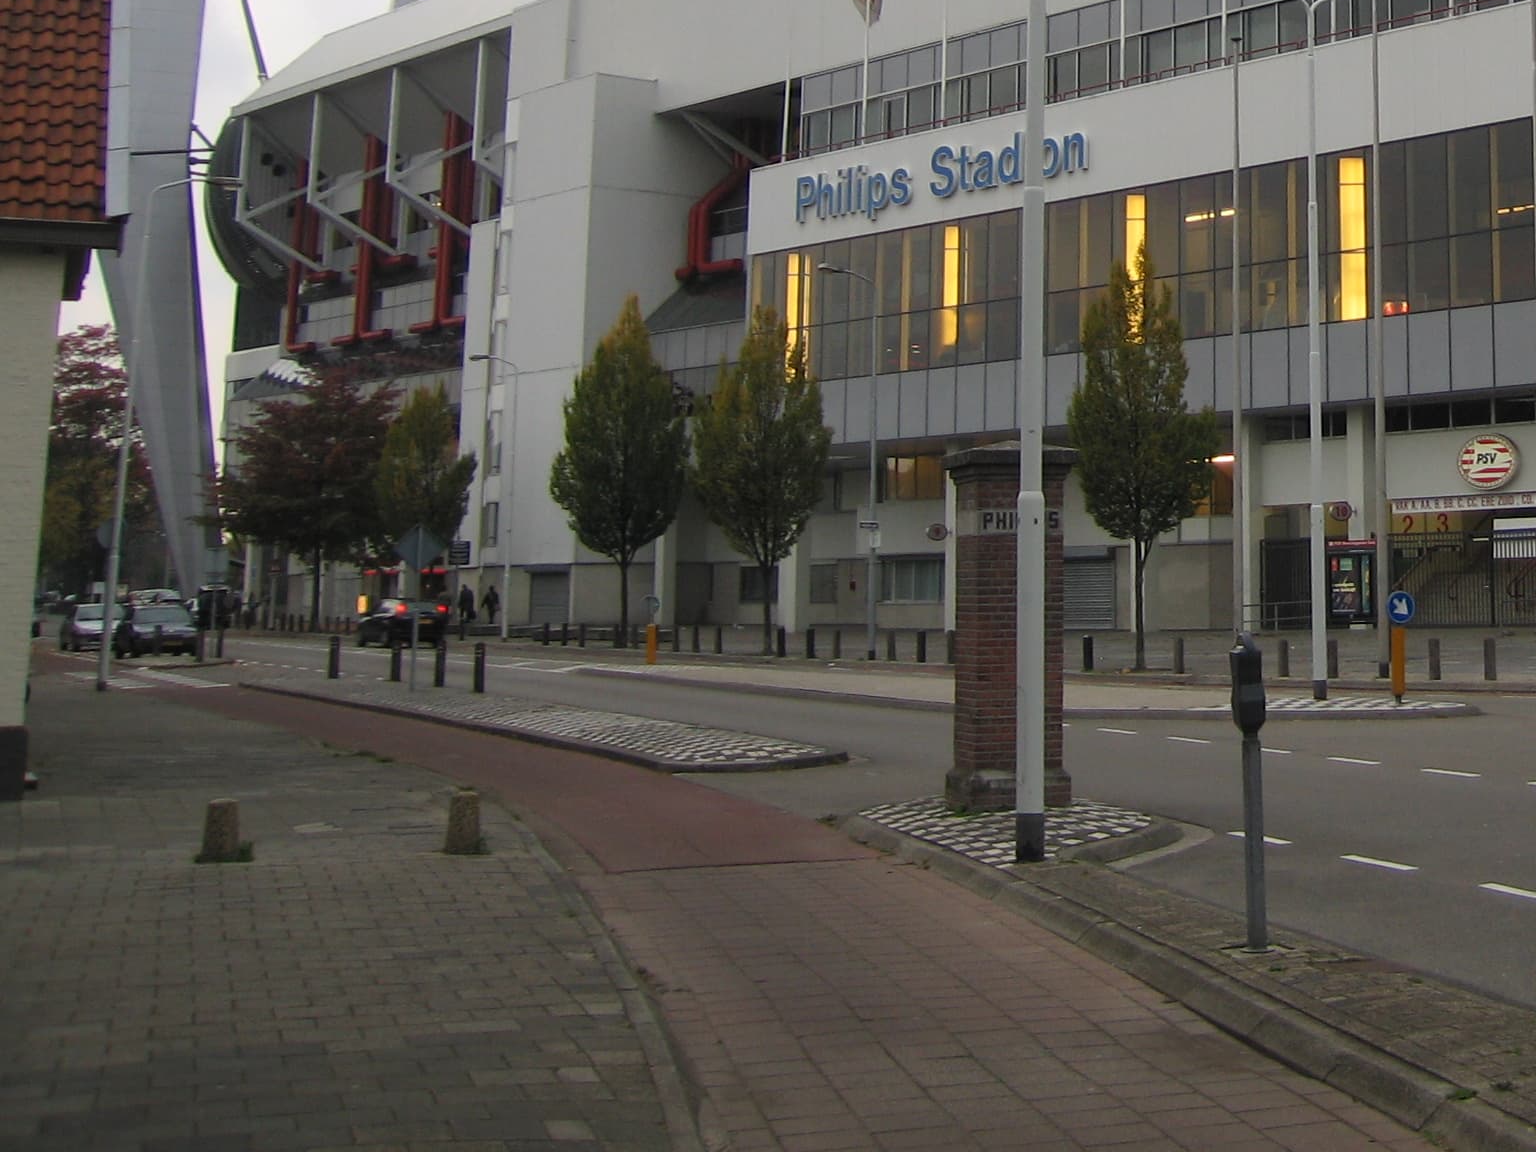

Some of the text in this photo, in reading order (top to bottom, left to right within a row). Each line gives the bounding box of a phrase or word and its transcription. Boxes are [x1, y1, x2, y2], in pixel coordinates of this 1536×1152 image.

[796, 132, 1089, 223] Philips Stadon
[1476, 453, 1497, 464] PSV
[983, 511, 1059, 530] PHIS
[1336, 507, 1347, 517] 10
[1402, 515, 1414, 534] 2
[1437, 513, 1448, 533] 3
